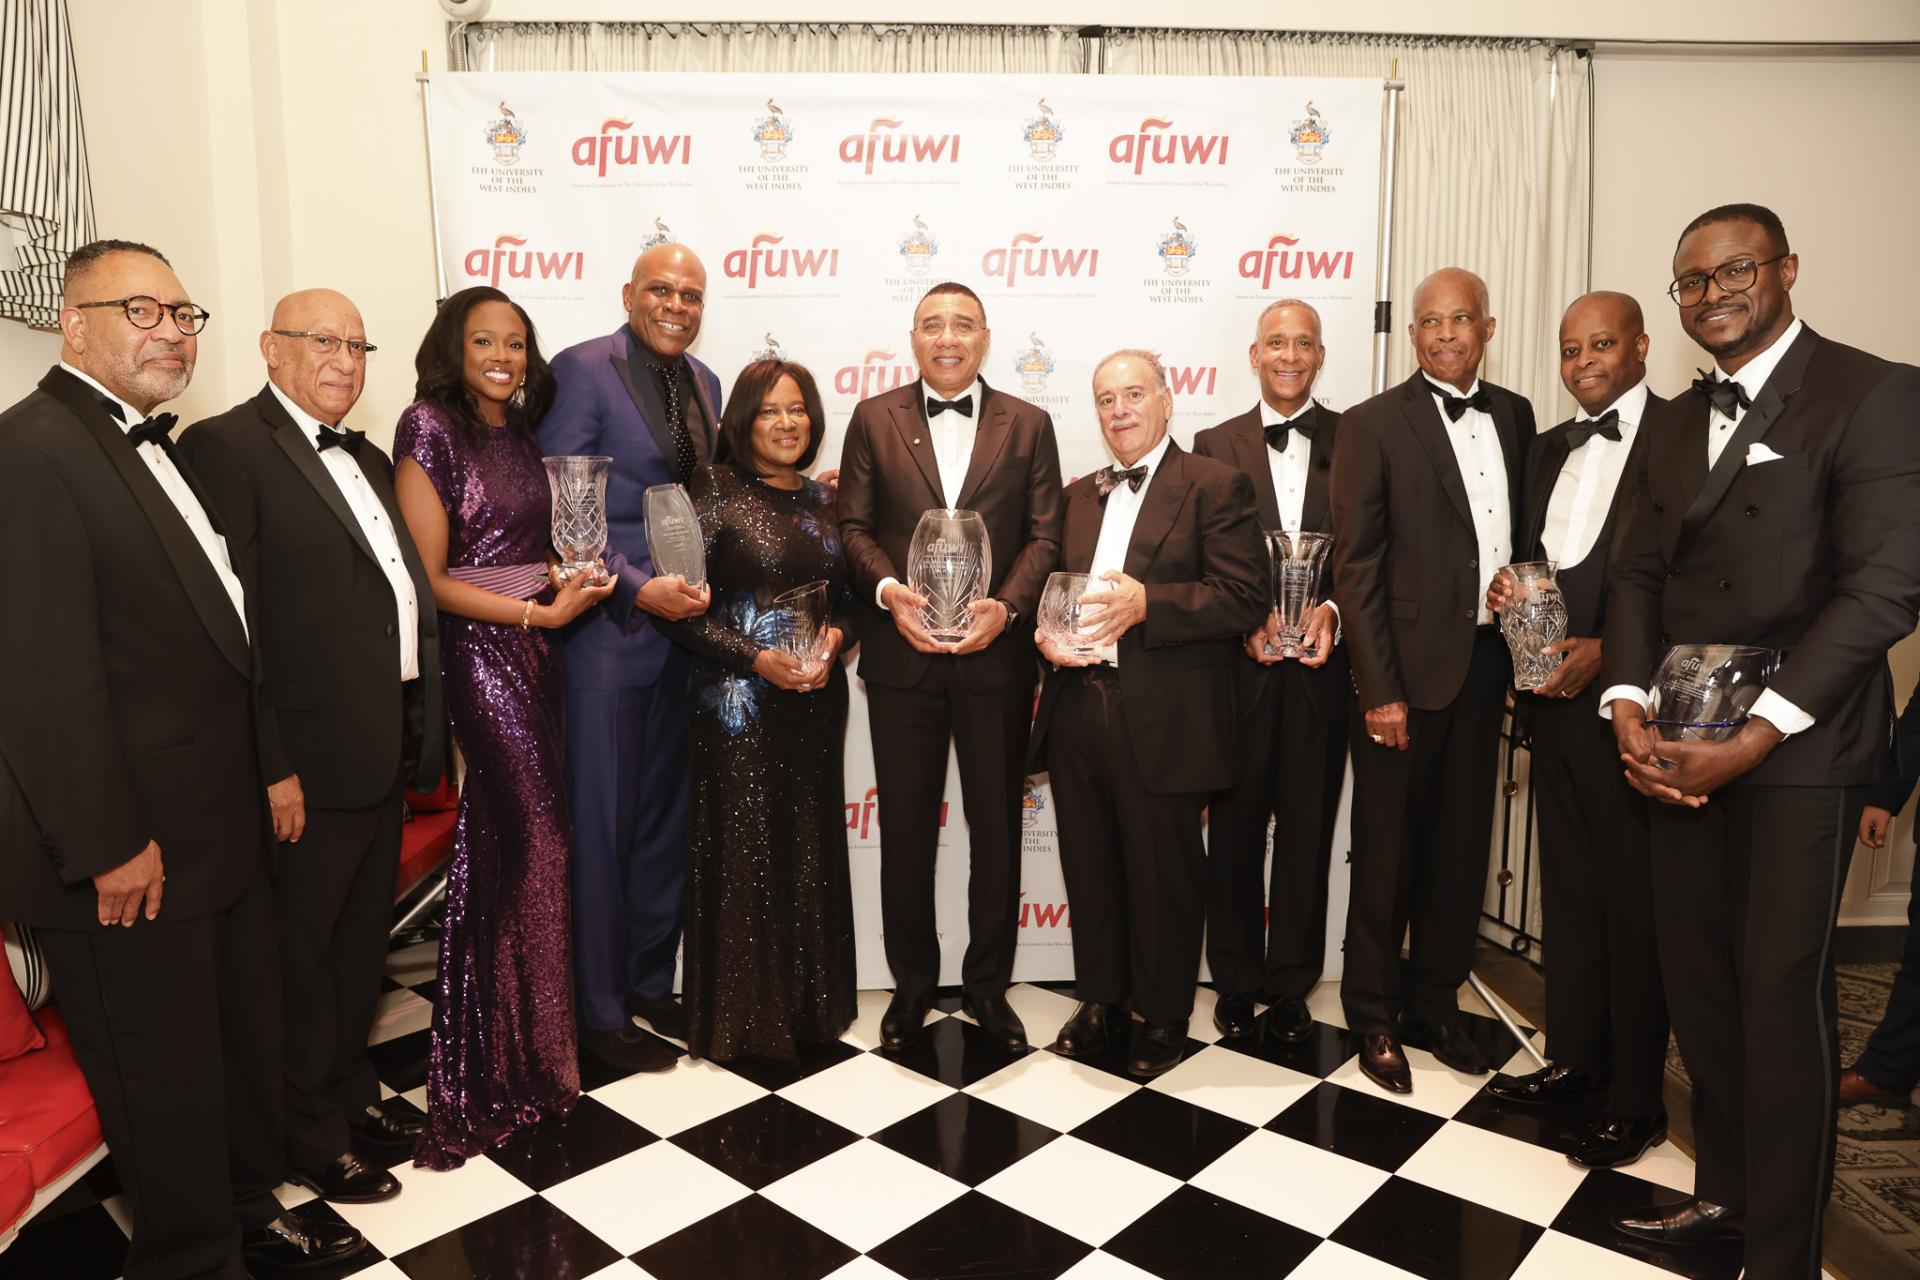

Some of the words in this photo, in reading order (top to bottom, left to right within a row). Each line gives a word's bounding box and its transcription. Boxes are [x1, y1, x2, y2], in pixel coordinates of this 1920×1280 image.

[471, 166, 488, 174] THE
[491, 168, 544, 176] UNIVERSITY
[738, 164, 754, 172] THE
[757, 164, 810, 173] UNIVERSITY
[1008, 164, 1024, 172] THE
[1026, 164, 1080, 172] UNIVERSITY
[1293, 168, 1344, 176] UNIVERSITY
[1293, 176, 1304, 184] OF
[1308, 176, 1324, 184] THE
[479, 184, 502, 192] WEST
[506, 185, 537, 193] INDIES
[745, 182, 768, 190] WEST
[771, 182, 802, 190] INDIES
[1040, 182, 1072, 190] INDIES
[1281, 184, 1304, 192] WEST
[1306, 184, 1336, 192] INDIES
[1161, 279, 1212, 287] UNIVERSITY
